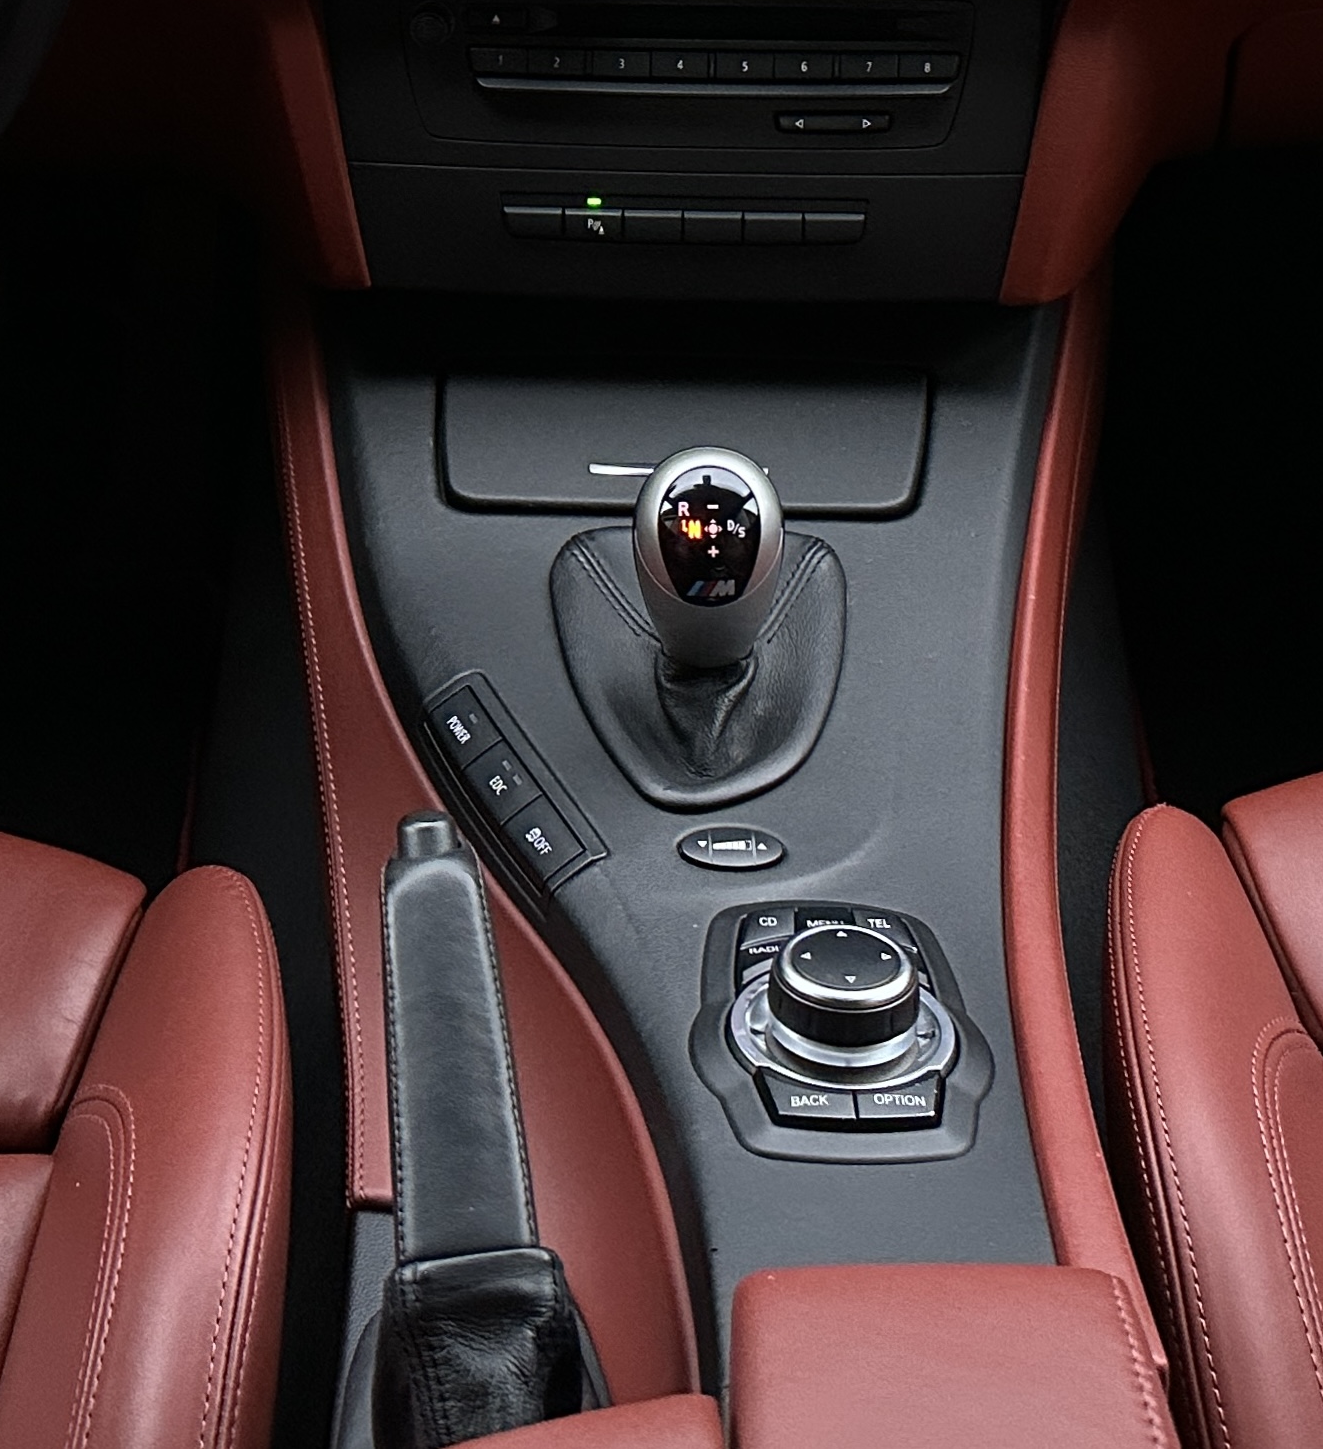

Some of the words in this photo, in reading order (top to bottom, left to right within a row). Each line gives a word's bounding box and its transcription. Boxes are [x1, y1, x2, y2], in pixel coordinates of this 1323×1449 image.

[553, 56, 560, 68] 2
[619, 58, 626, 69] 3
[676, 59, 684, 70] 4
[742, 61, 749, 72] 5
[801, 61, 808, 73] 6
[866, 61, 873, 73] 7
[924, 62, 931, 73] 8
[678, 501, 690, 517] R
[727, 519, 746, 538] D/S
[446, 715, 471, 745] POWER
[489, 775, 508, 796] EDC
[759, 917, 777, 927] CD
[867, 918, 891, 929] TEL
[790, 1094, 828, 1107] BACK
[873, 1093, 927, 1107] OPTION
